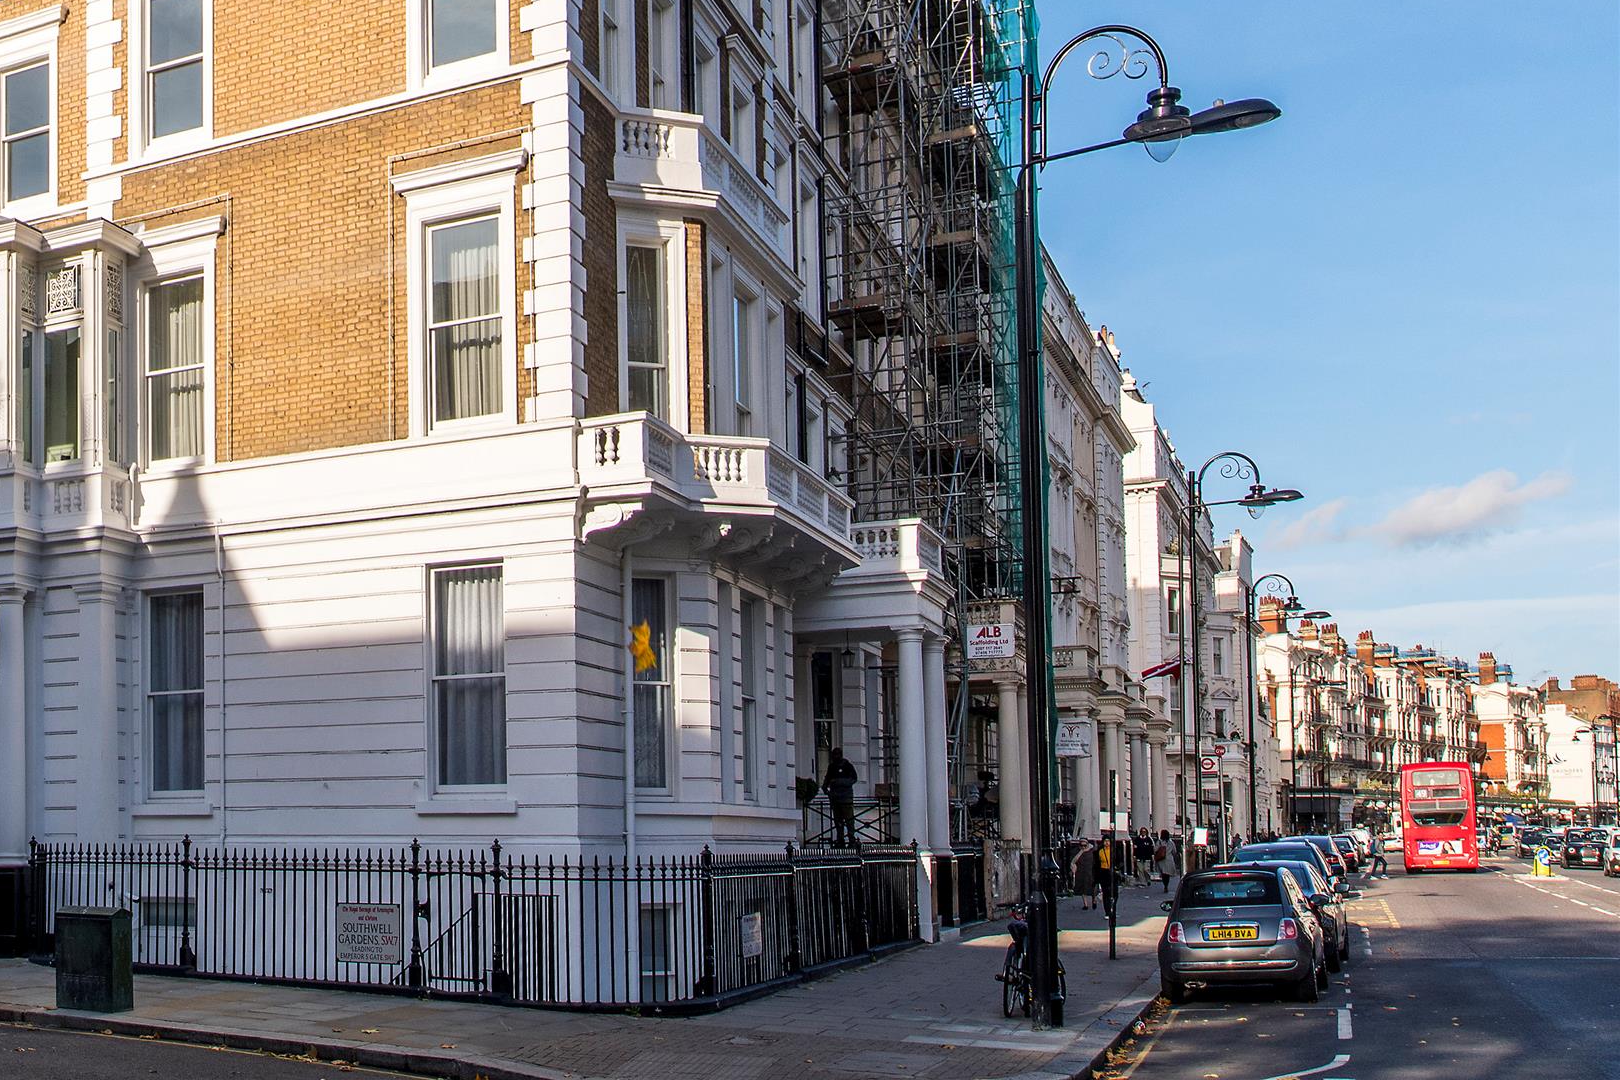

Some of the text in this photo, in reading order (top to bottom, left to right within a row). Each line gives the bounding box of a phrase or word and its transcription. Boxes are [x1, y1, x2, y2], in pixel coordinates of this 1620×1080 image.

[976, 626, 1001, 638] ALB
[342, 923, 393, 934] SOUTHWELL
[1212, 930, 1252, 938] LH14 BVA
